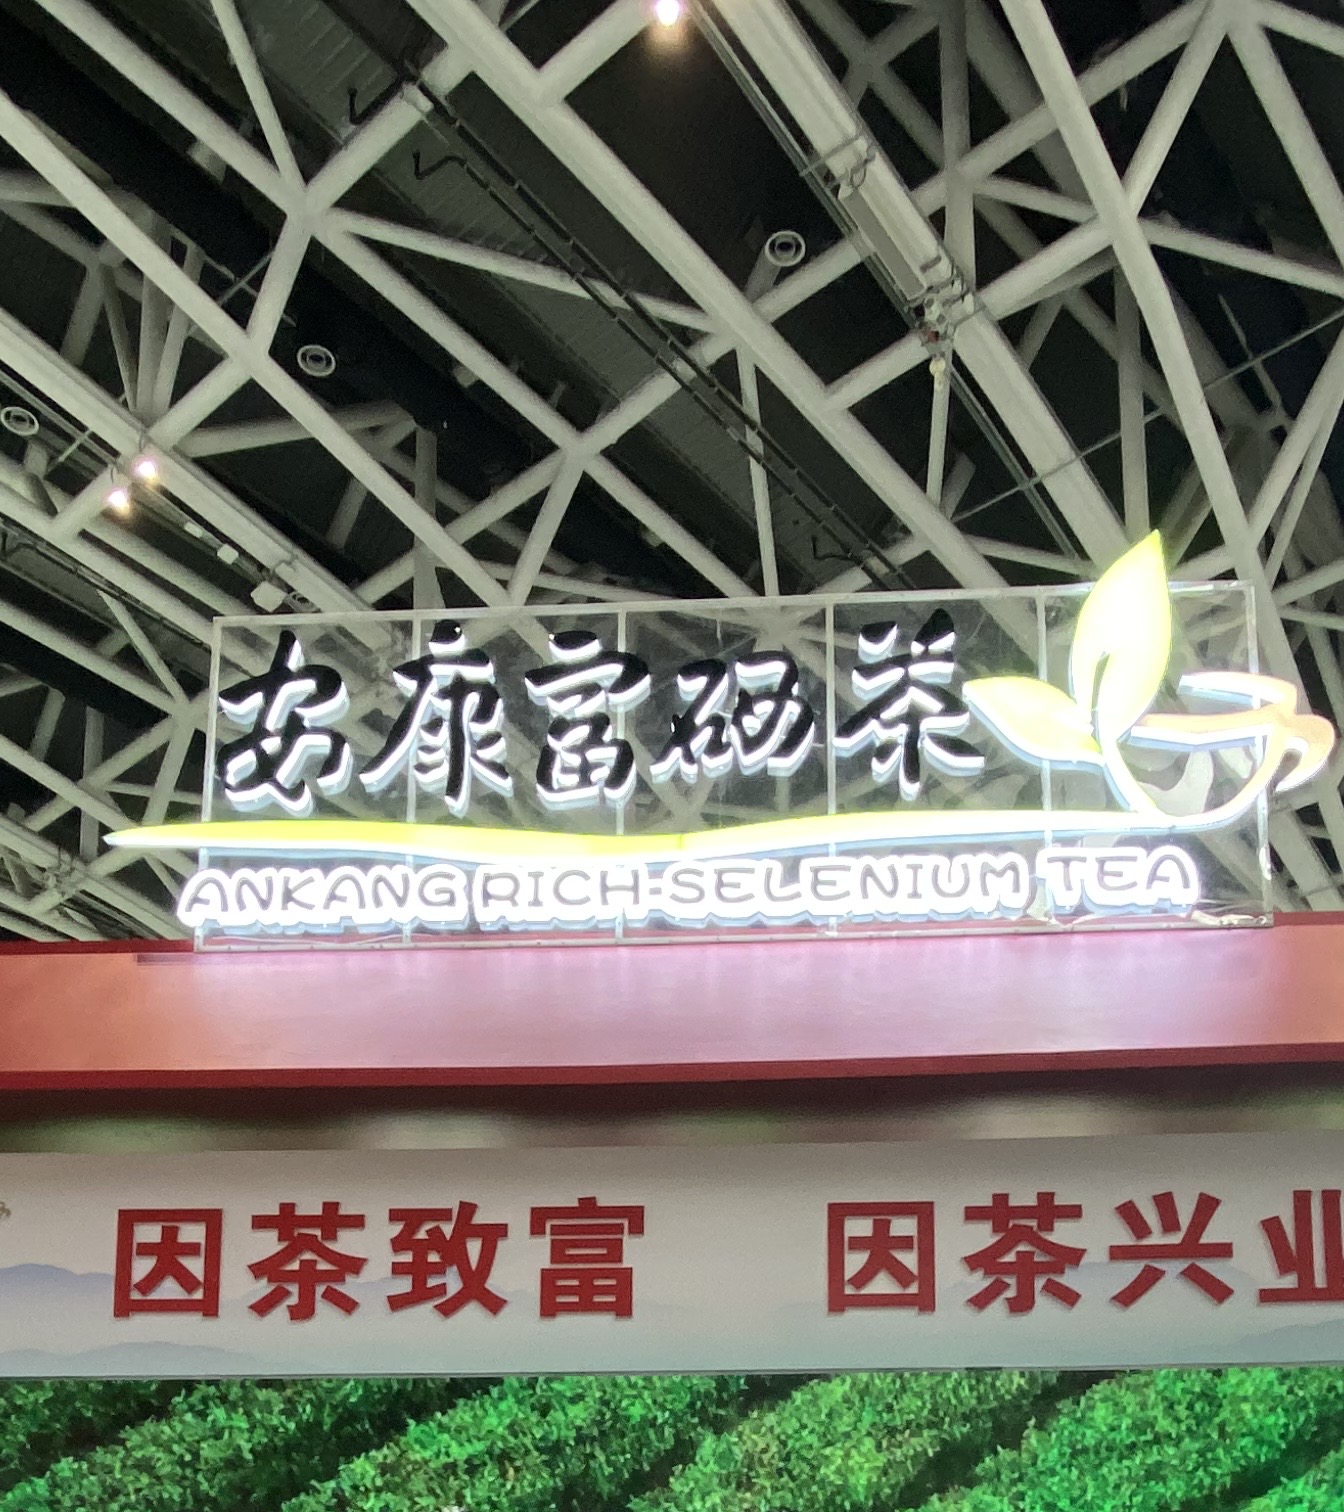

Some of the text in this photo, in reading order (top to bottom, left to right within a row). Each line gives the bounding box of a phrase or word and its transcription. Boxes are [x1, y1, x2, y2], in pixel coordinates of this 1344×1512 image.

[216, 609, 987, 815] 安康富硒茶
[181, 850, 1193, 914] ANKANG RICH-SELENIUM TEA
[112, 1197, 646, 1323] 因茶致富
